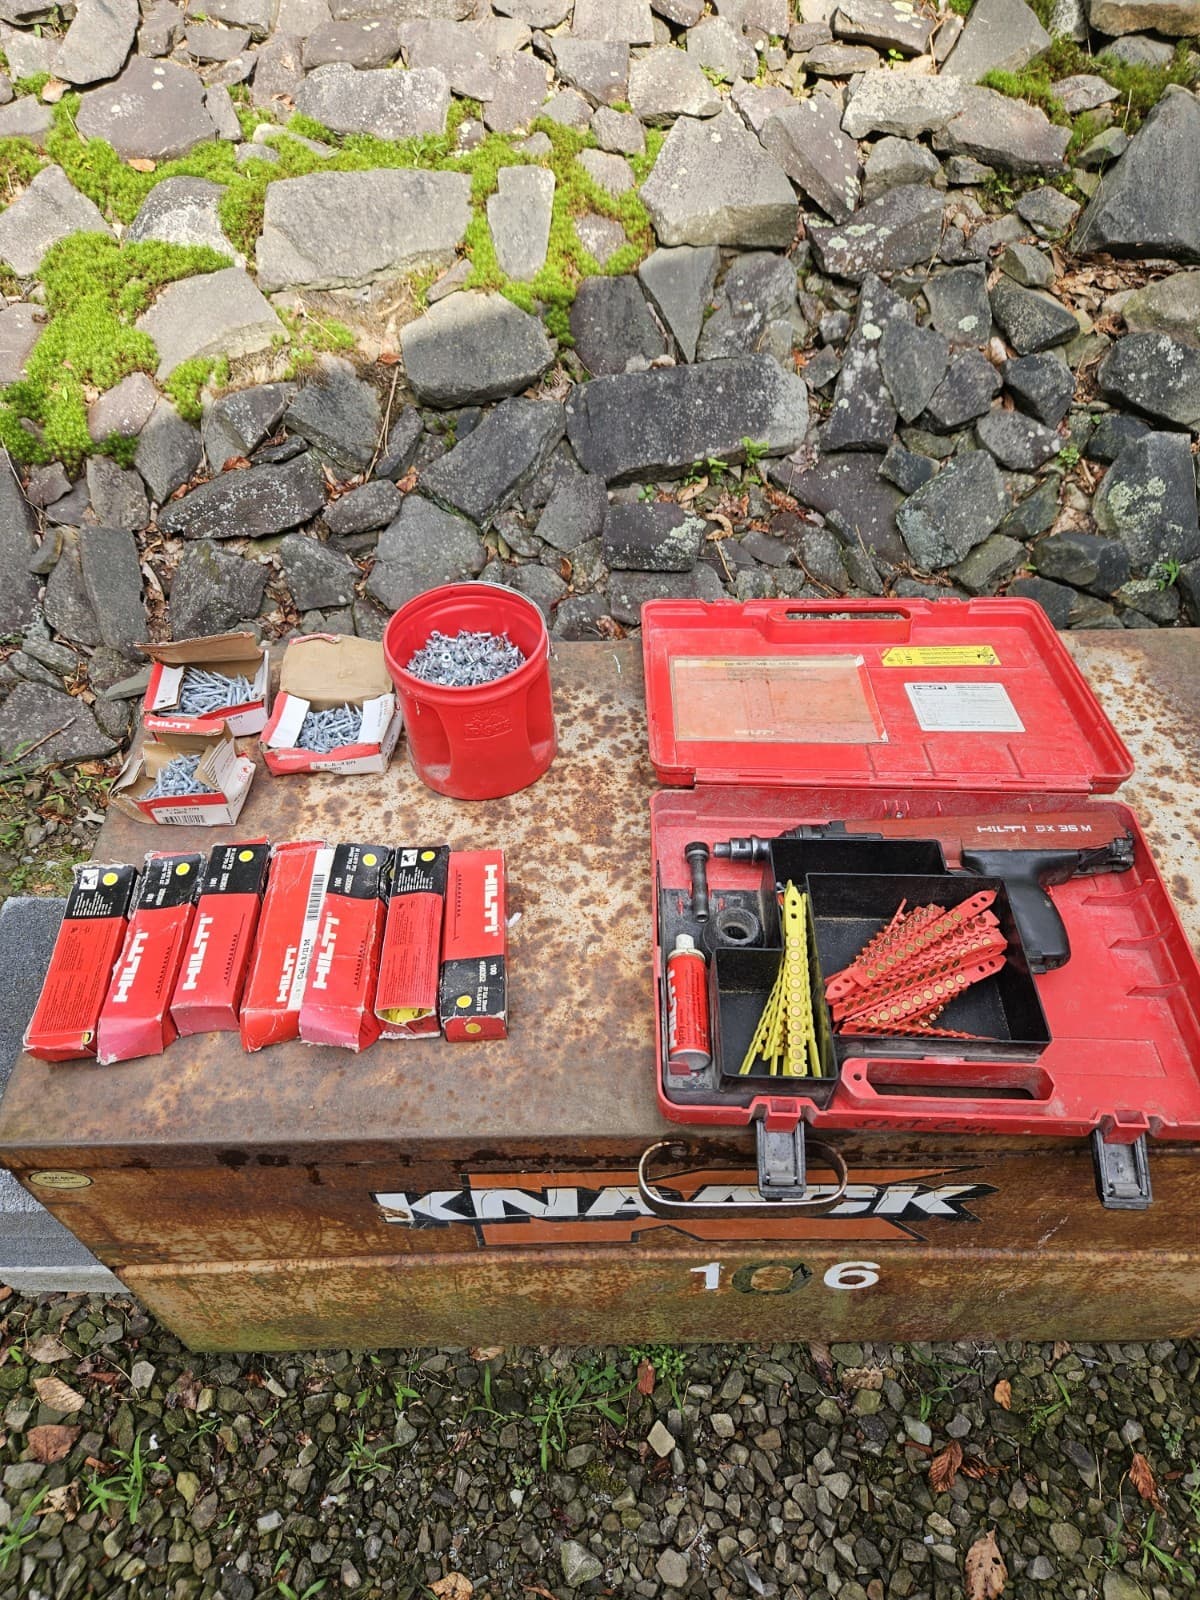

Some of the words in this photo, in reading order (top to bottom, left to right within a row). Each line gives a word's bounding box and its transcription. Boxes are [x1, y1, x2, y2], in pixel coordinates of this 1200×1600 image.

[147, 719, 191, 730] HILTI
[976, 824, 1027, 833] HILTI
[1034, 824, 1055, 833] DX
[1080, 824, 1093, 833] M
[484, 864, 498, 933] HILTI
[112, 932, 149, 1003] HILTI
[181, 917, 214, 990] HILTI
[276, 947, 297, 1003] HILTI
[312, 916, 340, 989] HILTI
